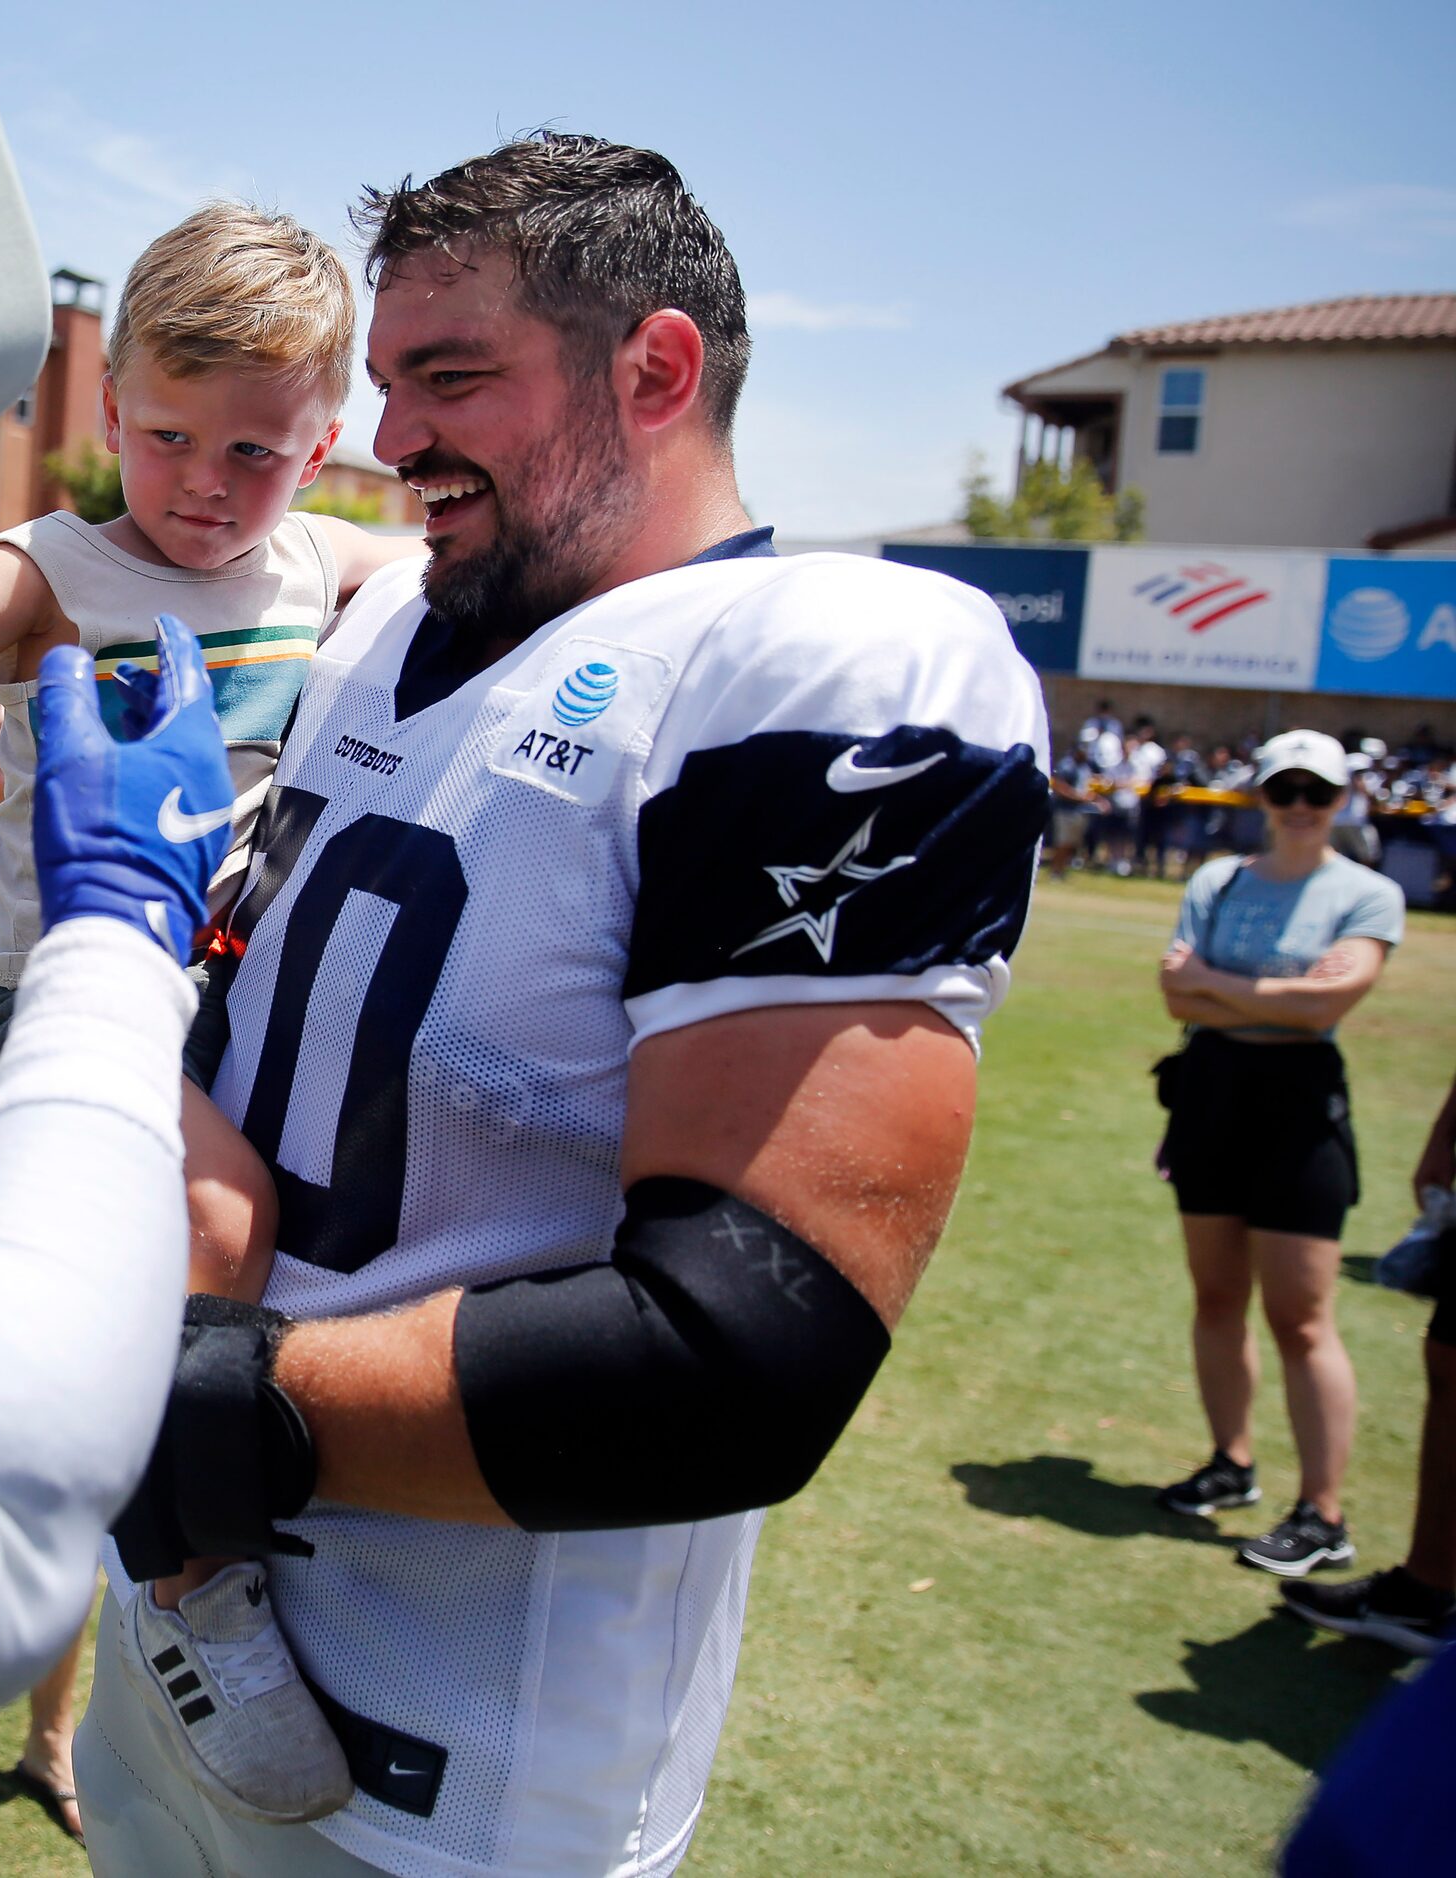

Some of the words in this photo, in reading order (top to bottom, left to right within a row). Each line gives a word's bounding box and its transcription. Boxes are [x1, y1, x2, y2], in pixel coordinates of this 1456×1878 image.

[992, 590, 1064, 627] epsi
[334, 735, 404, 776] COWBOYS
[513, 729, 594, 776] AT&T
[709, 1211, 812, 1311] XXL
